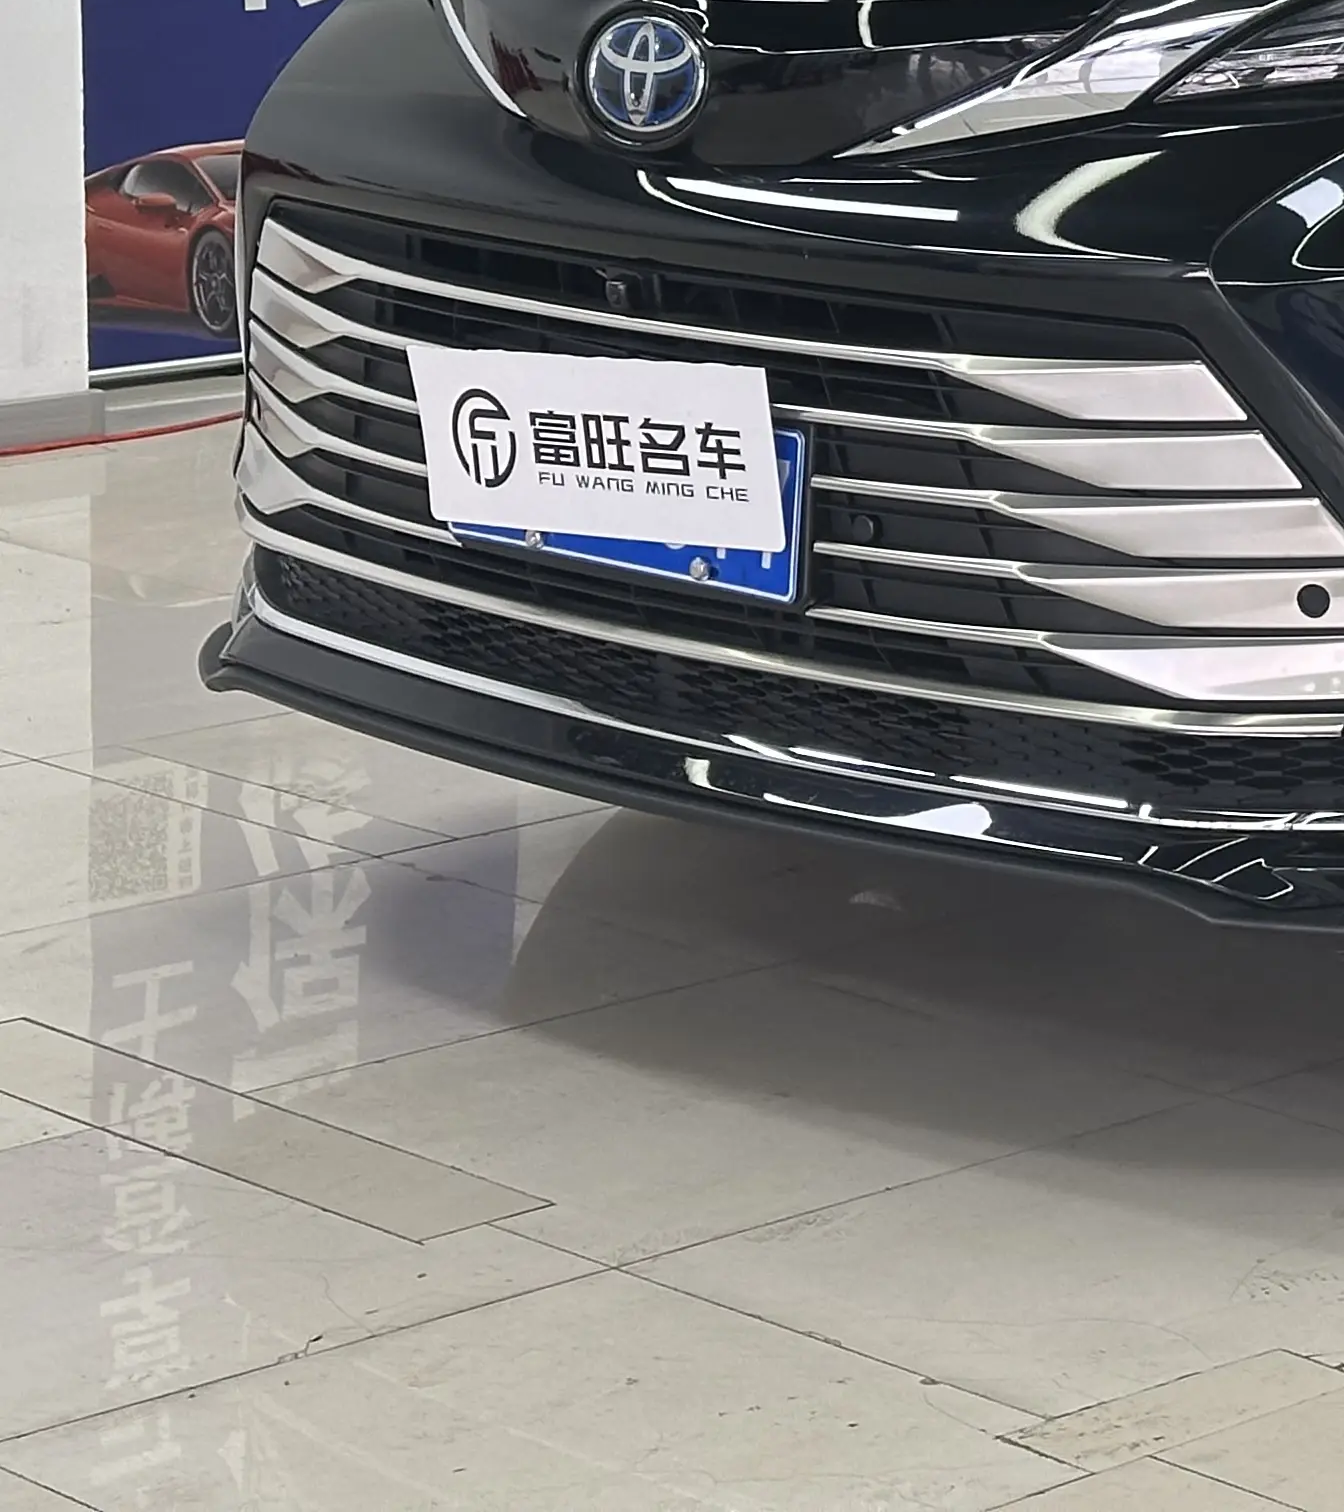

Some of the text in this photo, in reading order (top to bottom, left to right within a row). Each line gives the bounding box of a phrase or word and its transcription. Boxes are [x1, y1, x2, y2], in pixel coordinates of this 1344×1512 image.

[528, 410, 746, 480] 富旺名车
[538, 472, 750, 503] FU WANG MING CHE
